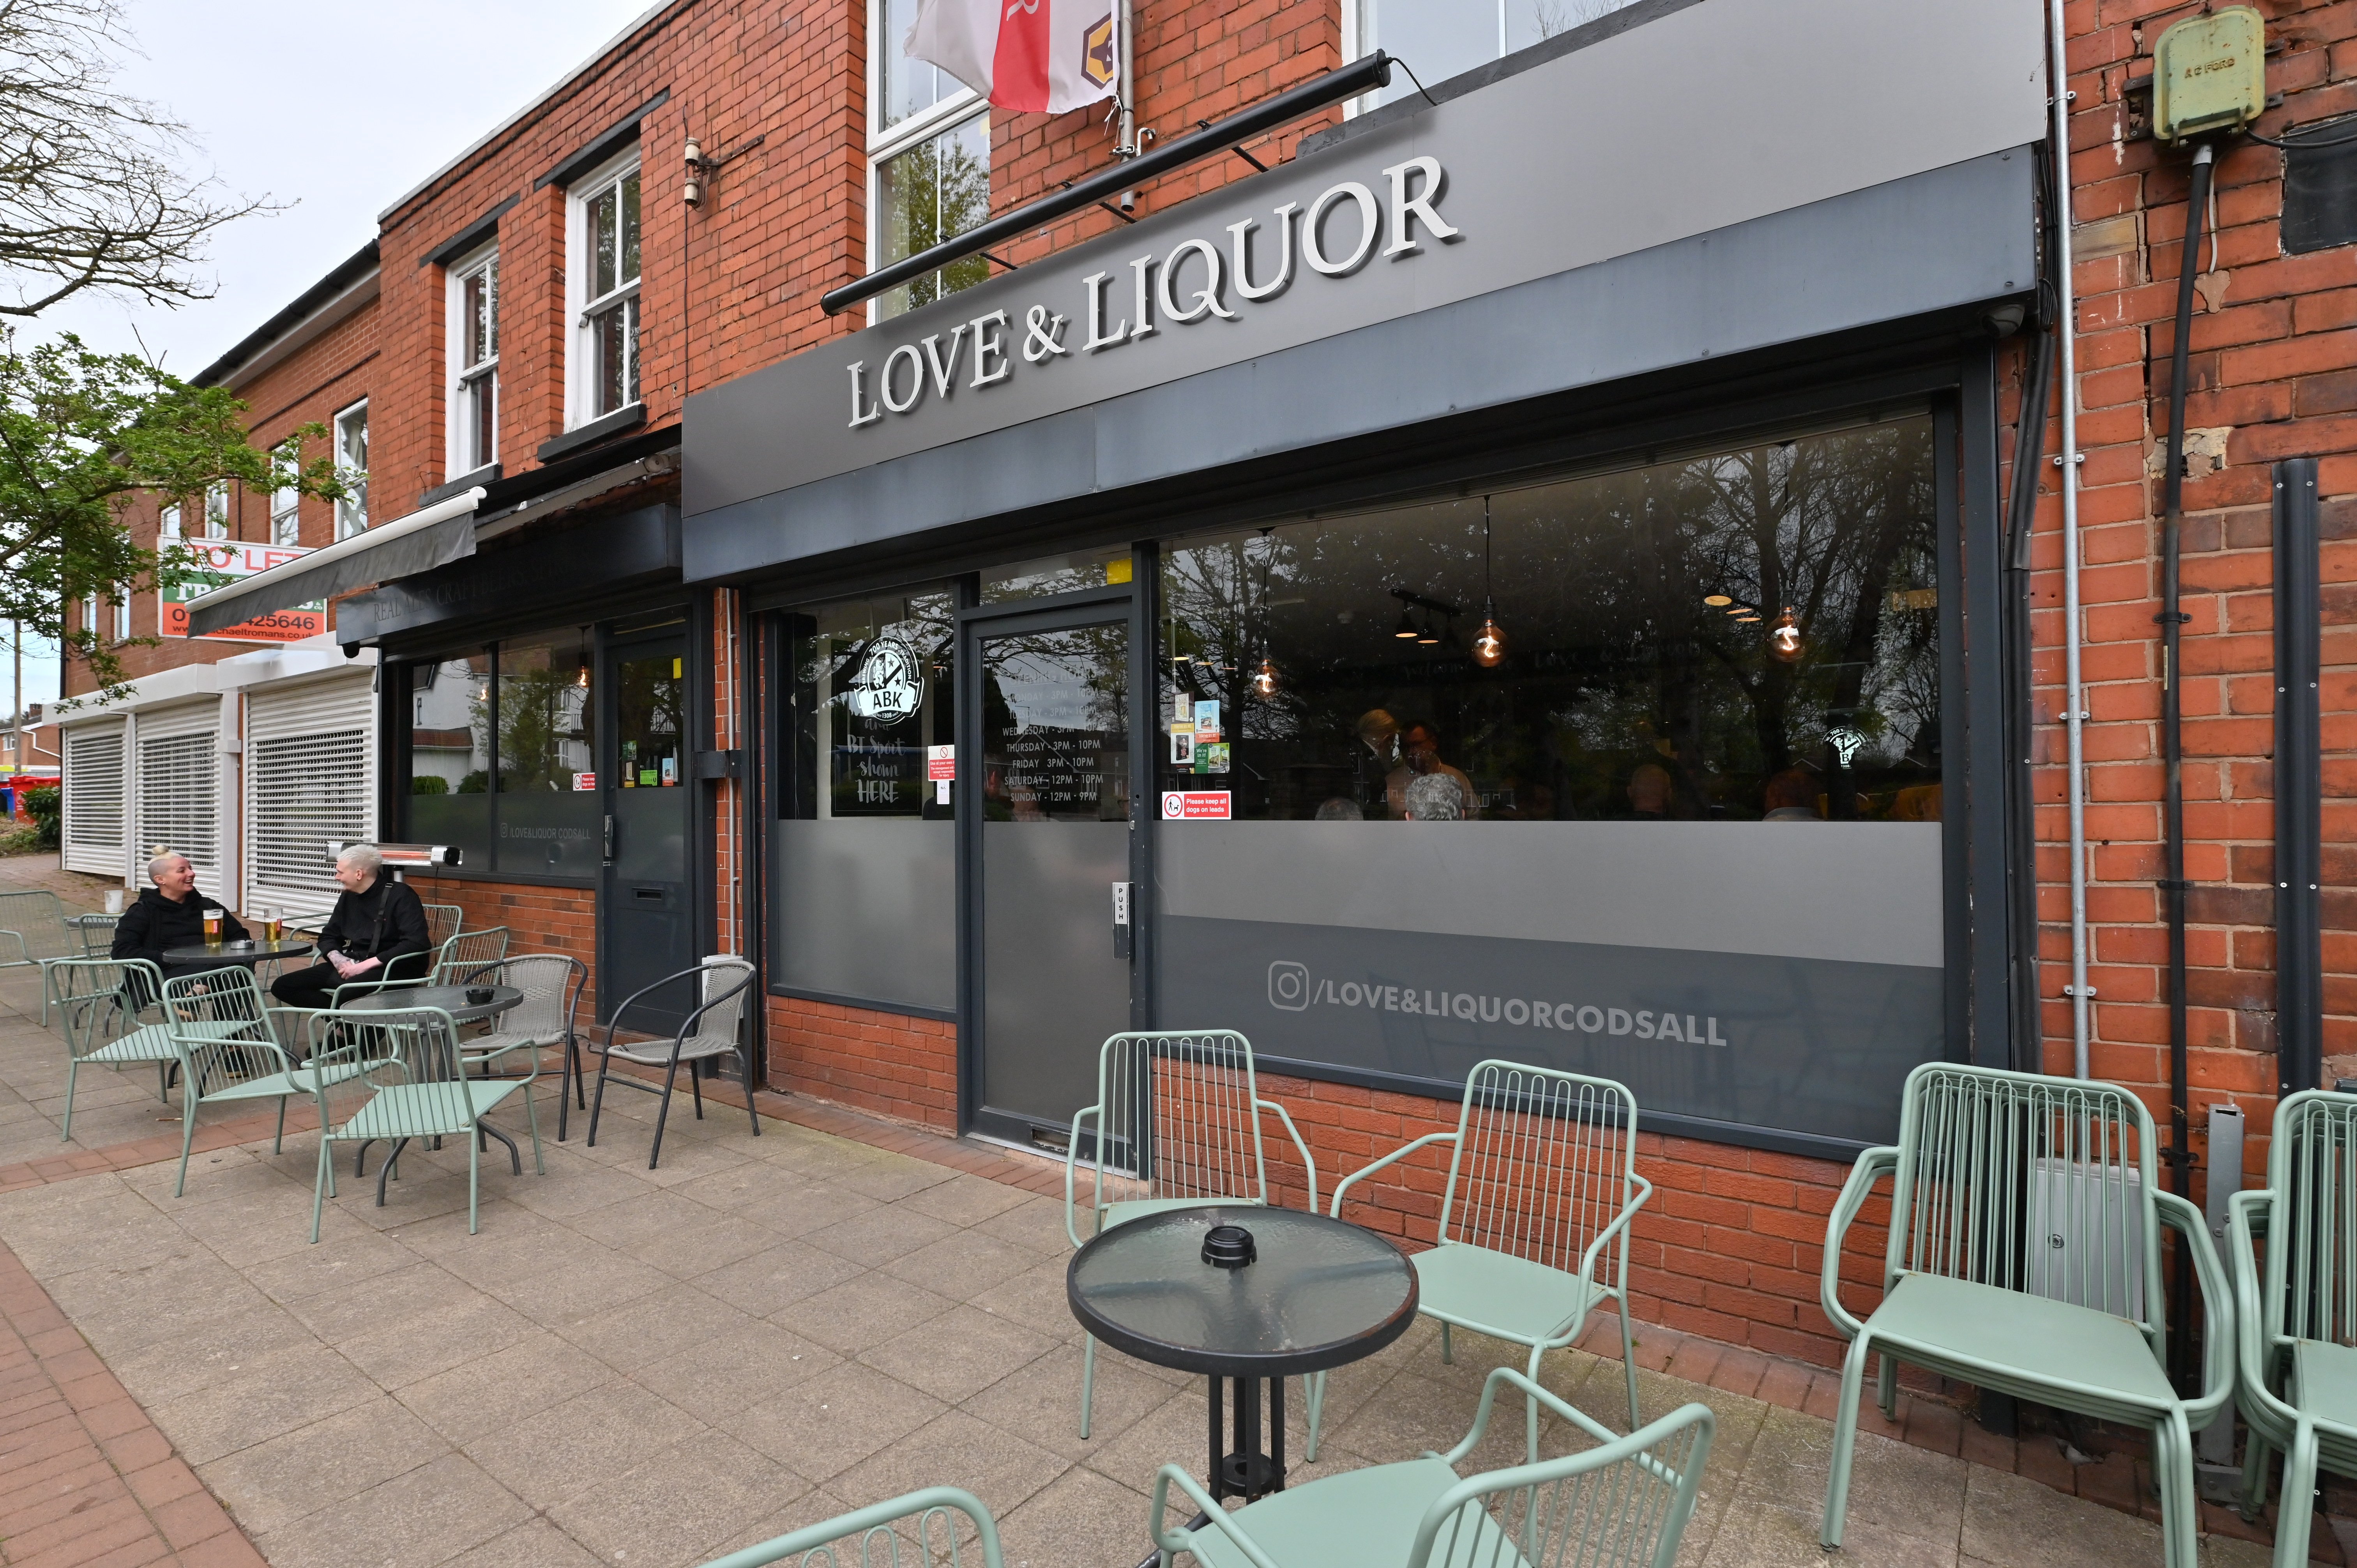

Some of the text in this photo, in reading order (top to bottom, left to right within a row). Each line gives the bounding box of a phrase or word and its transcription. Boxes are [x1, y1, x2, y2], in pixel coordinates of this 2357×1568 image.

[848, 155, 1458, 428] LOVE & LIQUOR
[182, 544, 232, 569] TO
[374, 598, 401, 623] REAL
[869, 643, 880, 656] 700
[881, 641, 898, 652] YEARS
[900, 649, 912, 679] TRADITION
[1009, 671, 1057, 685] OPENING
[873, 691, 903, 710] ABK
[1009, 692, 1043, 703] MONDAY
[1051, 689, 1068, 699] 3PM
[1077, 687, 1099, 697] 10PM
[1009, 708, 1042, 720] TUESDAY
[1050, 706, 1067, 717] 3PM
[1075, 704, 1097, 715] 10PM
[1003, 725, 1050, 736] WEDNESDAY
[1057, 724, 1074, 733] 3PM
[847, 734, 905, 759] BT Sport
[1006, 742, 1045, 752] THURSDAY
[1053, 741, 1070, 750] 3PM
[1078, 740, 1100, 749] 10PM
[857, 756, 899, 777] shown
[1013, 759, 1039, 768] FRIDAY
[1047, 758, 1064, 768] 3PM
[1072, 757, 1094, 766] 10PM
[1004, 775, 1044, 785] SATURDAY
[1052, 775, 1072, 784] 12PM
[1081, 774, 1103, 784] 10PM
[855, 779, 899, 803] HERE
[1011, 792, 1042, 802] SUNDAY
[1050, 792, 1071, 801] 12PM
[1079, 791, 1097, 801] 9PM
[510, 827, 591, 840] /LOVE&LIQUOR CODSALL
[1314, 979, 1727, 1047] /LOVE&LIQUORCODSALL
